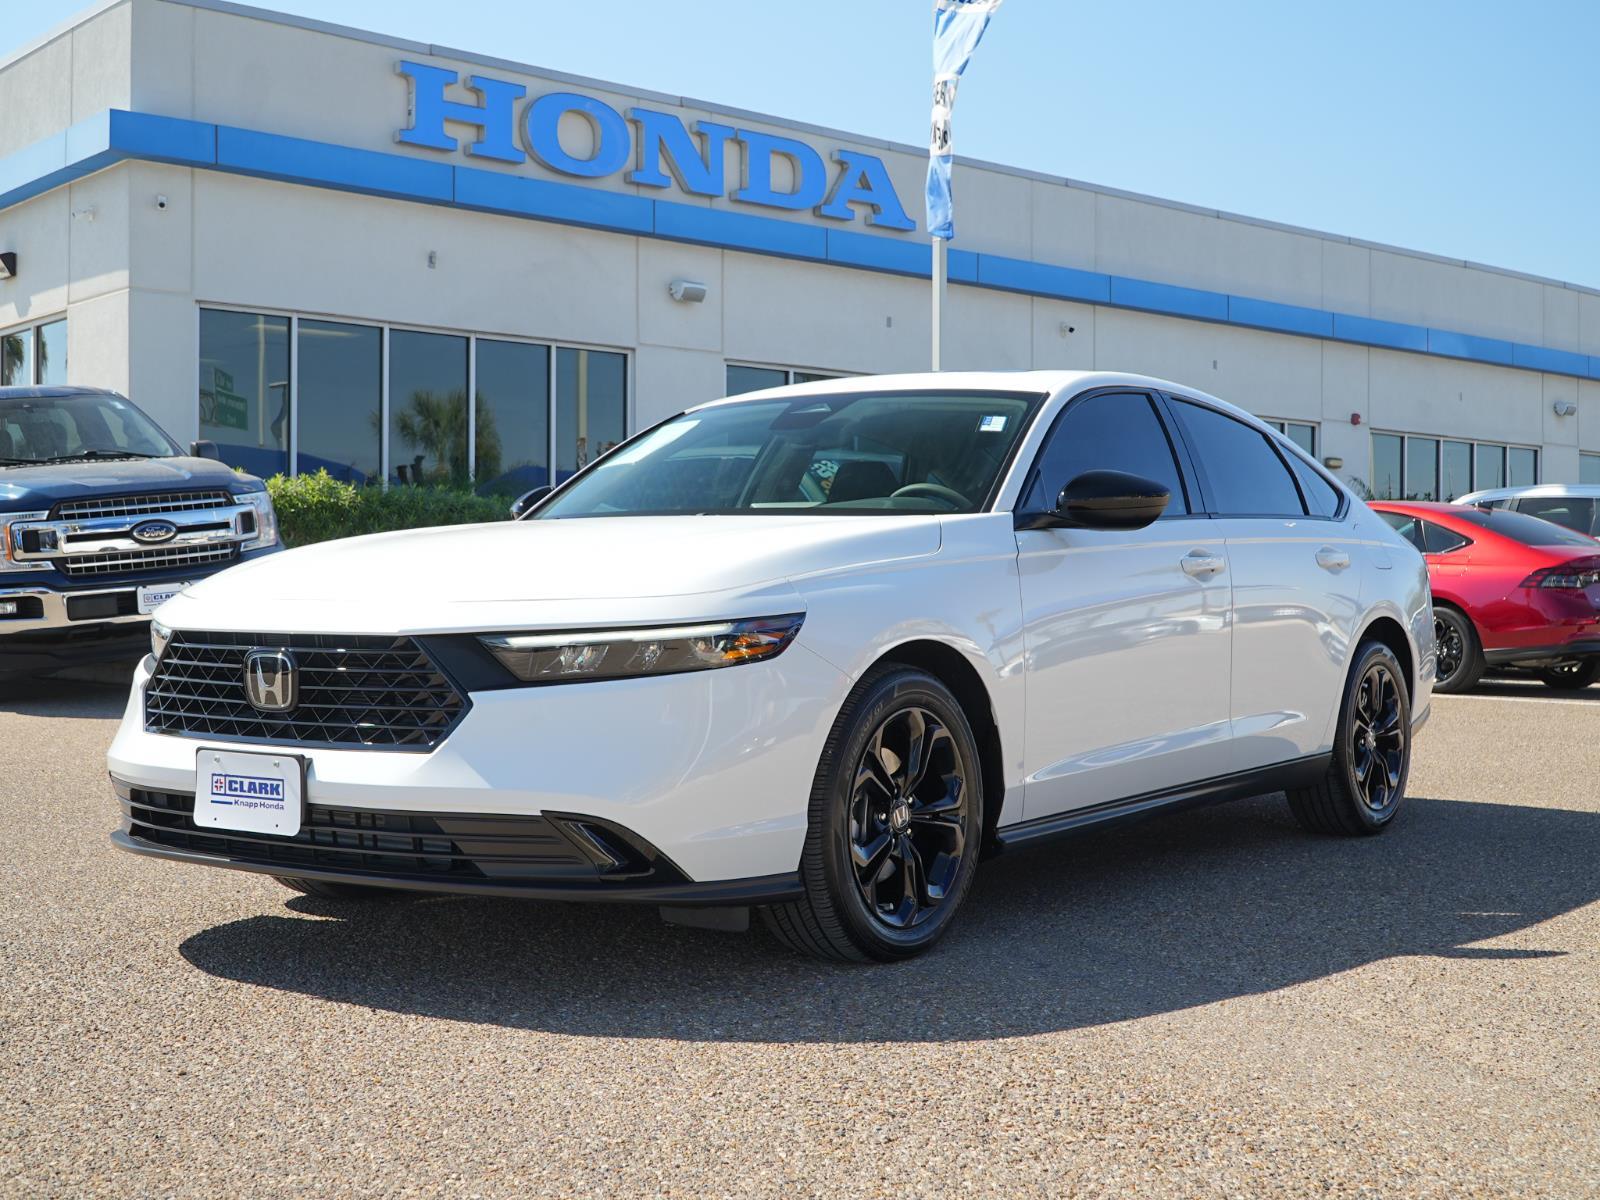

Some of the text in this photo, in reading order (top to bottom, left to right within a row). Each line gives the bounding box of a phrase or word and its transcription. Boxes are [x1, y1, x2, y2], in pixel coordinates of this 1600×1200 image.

[394, 60, 916, 232] HONDA
[143, 527, 167, 537] Ford
[228, 779, 281, 796] CLARK
[234, 799, 285, 811] Knapp Honda
